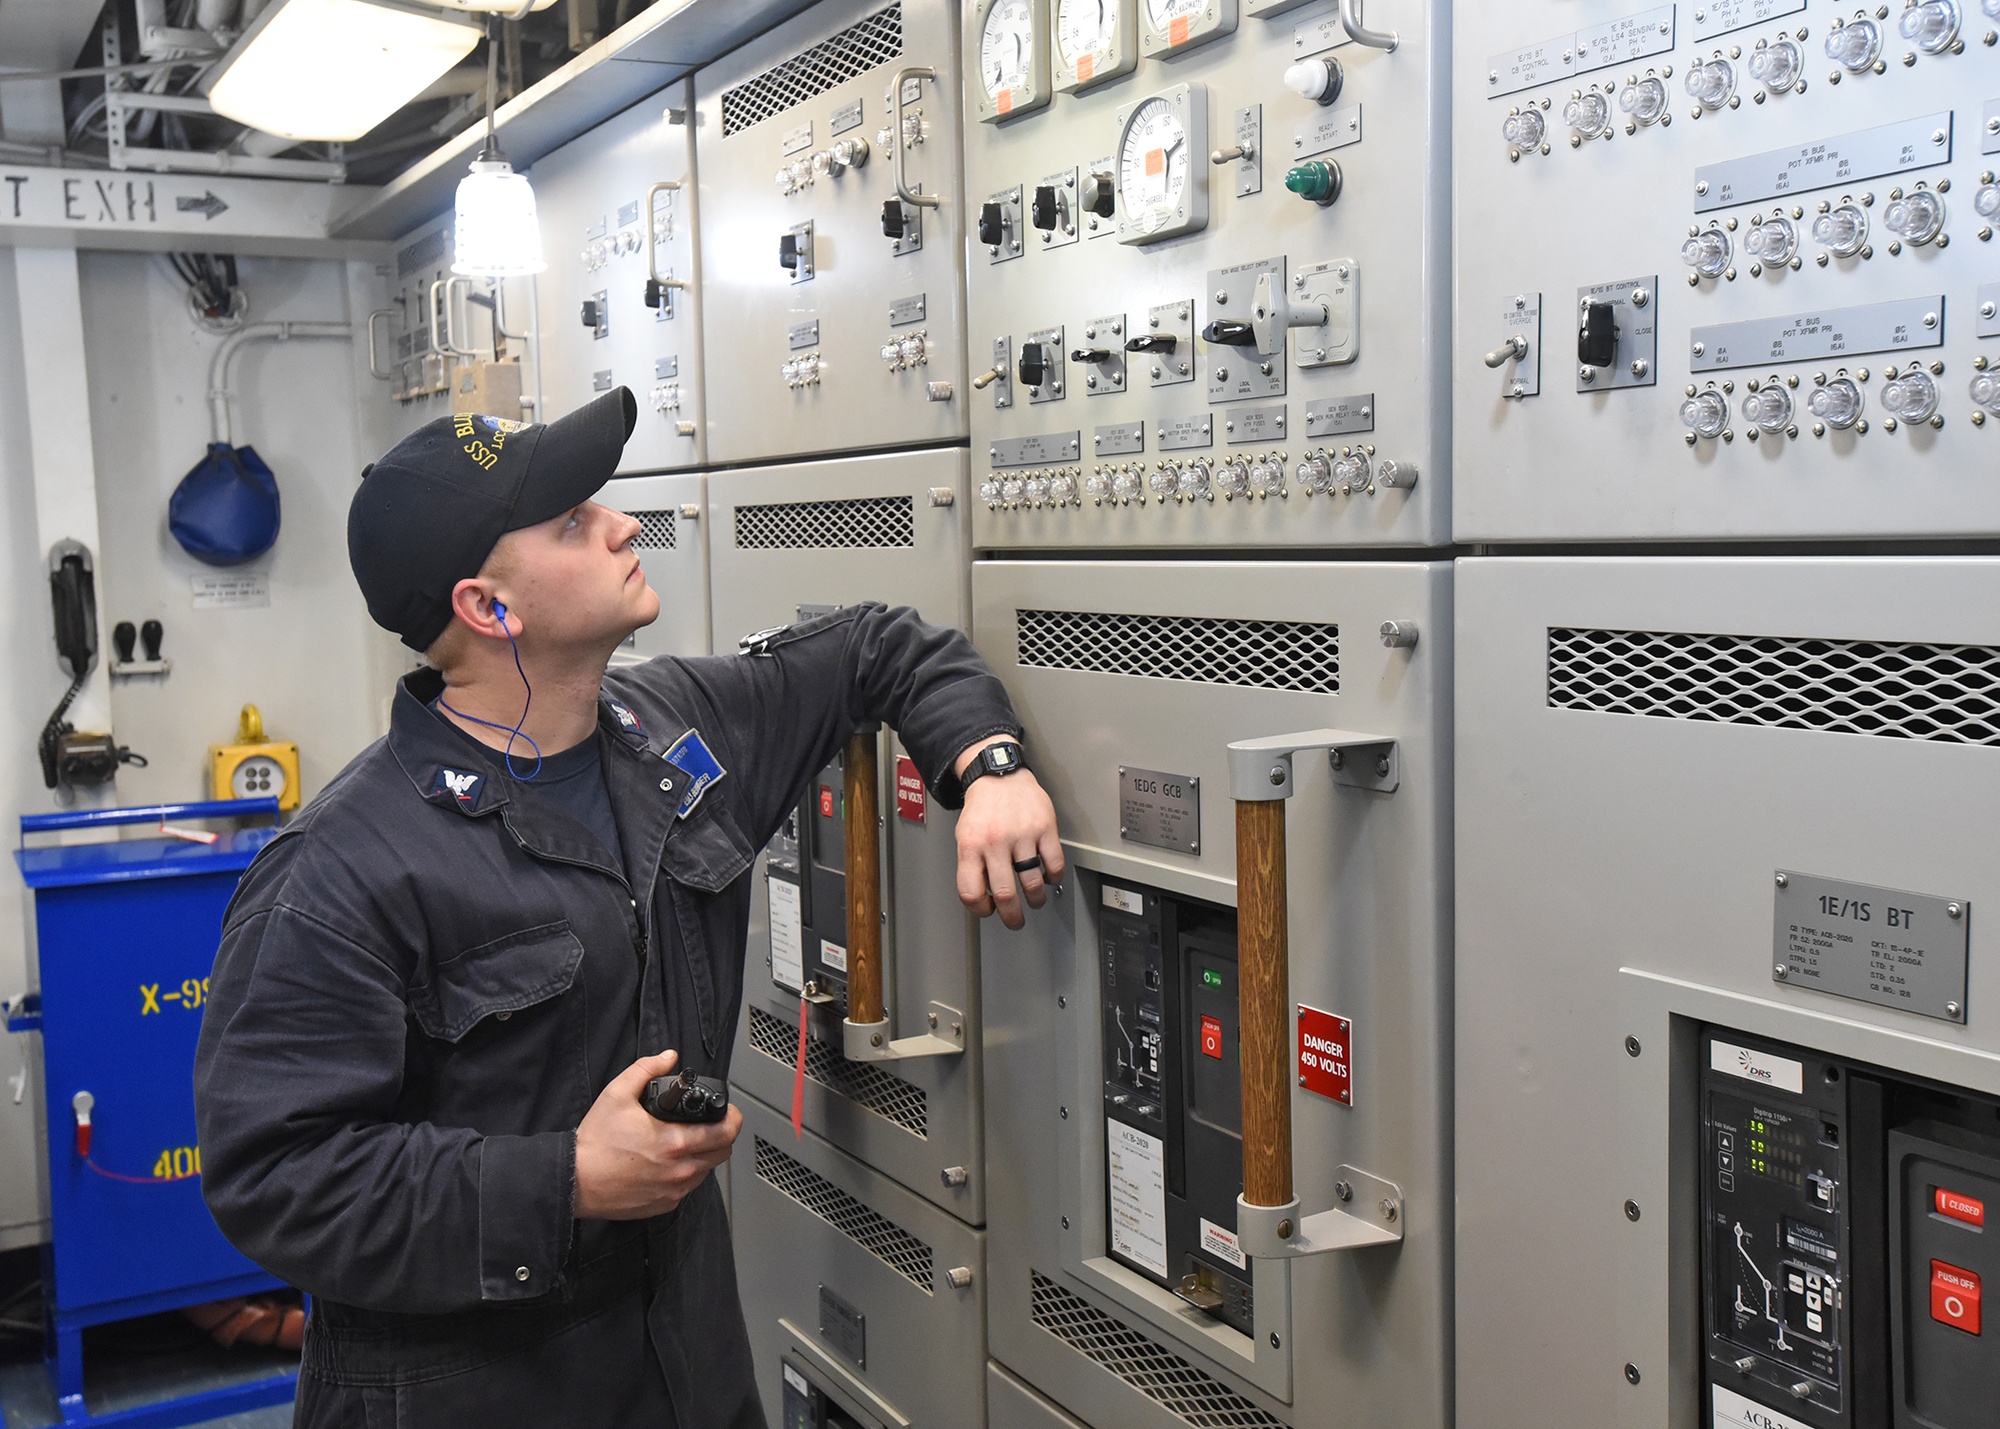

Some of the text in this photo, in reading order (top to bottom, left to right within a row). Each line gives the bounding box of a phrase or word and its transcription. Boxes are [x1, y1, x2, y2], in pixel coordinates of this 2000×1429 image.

[1721, 9, 1731, 18] PH
[1318, 20, 1336, 32] HEATER
[1621, 20, 1633, 30] BUS
[1628, 23, 1656, 37] SENSING
[1522, 60, 1549, 72] CONTROL
[1318, 122, 1334, 133] READY
[1322, 130, 1338, 141] START
[1811, 145, 1826, 155] BUS
[1788, 159, 1802, 169] POT
[1805, 155, 1825, 166] XFMR
[1616, 281, 1641, 291] CONTROL
[1806, 317, 1821, 326] BUS
[1783, 329, 1796, 338] POT
[1799, 327, 1819, 336] XFMR
[463, 440, 498, 471] USS
[900, 775, 921, 790] DANGER
[1133, 778, 1182, 799] 1EDG GCB
[908, 790, 923, 805] VOLTS
[1818, 895, 1914, 930] 1E/1S BT
[1898, 955, 1923, 967] 2000A
[1304, 1033, 1343, 1059] DANGER
[1301, 1052, 1347, 1078] 450 VOLTS
[1750, 1067, 1772, 1079] DRS
[1949, 1199, 1980, 1217] CLOSED
[1209, 1228, 1233, 1245] WARNING
[1937, 1270, 1975, 1291] PUSH OFF
